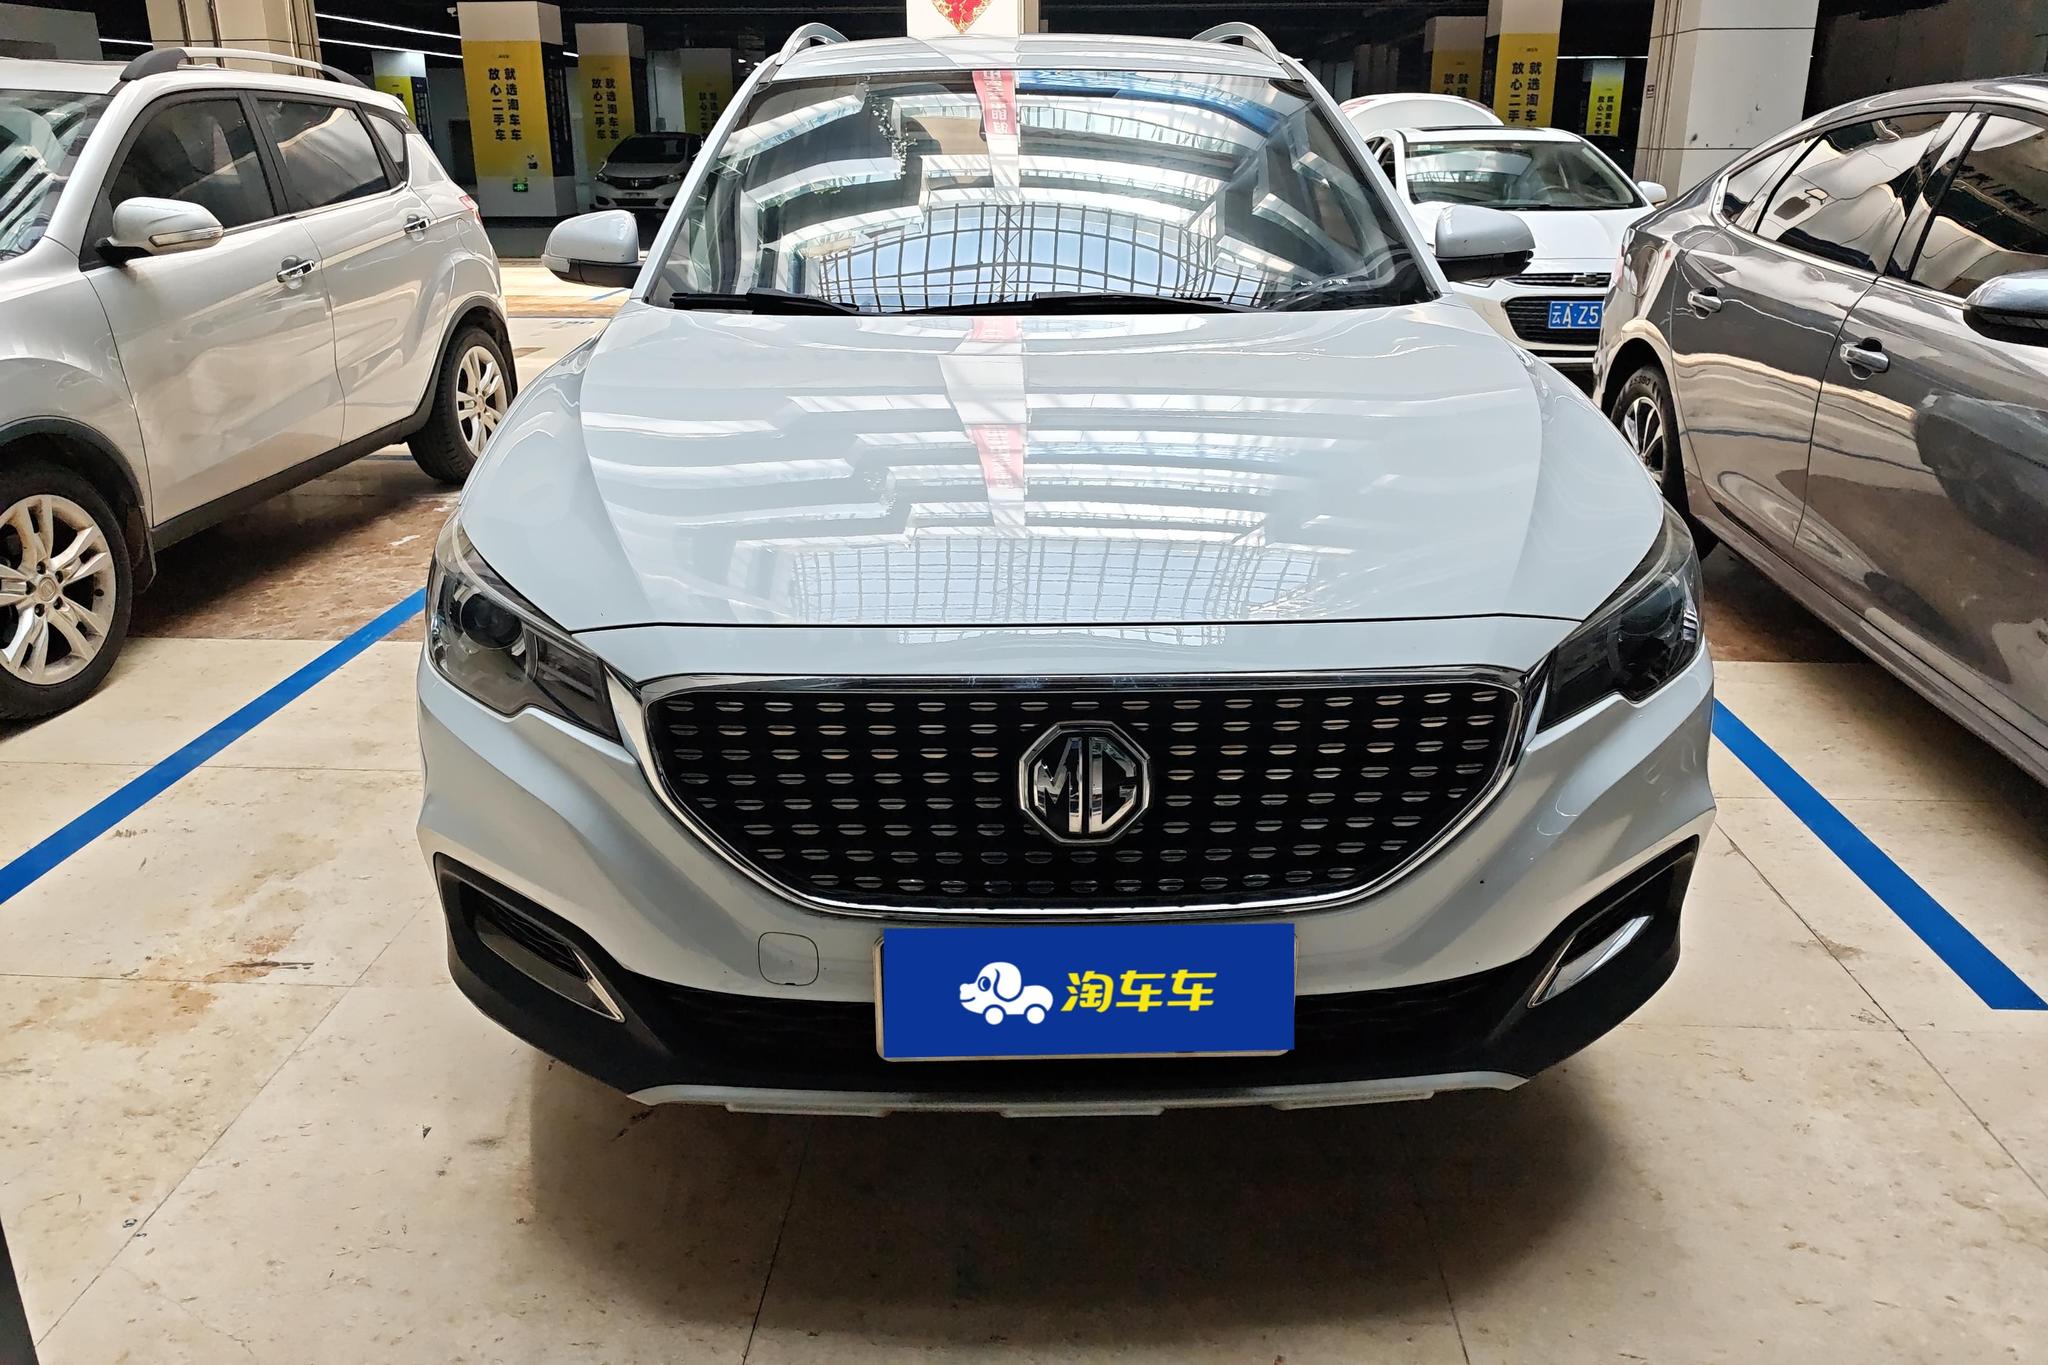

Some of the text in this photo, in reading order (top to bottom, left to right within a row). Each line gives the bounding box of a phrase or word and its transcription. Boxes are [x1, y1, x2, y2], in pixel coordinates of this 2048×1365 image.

[488, 68, 506, 141] 放心二手车
[504, 68, 522, 141] 就选淘车车
[1525, 62, 1542, 127] 就选淘车
[1034, 737, 1137, 834] MG
